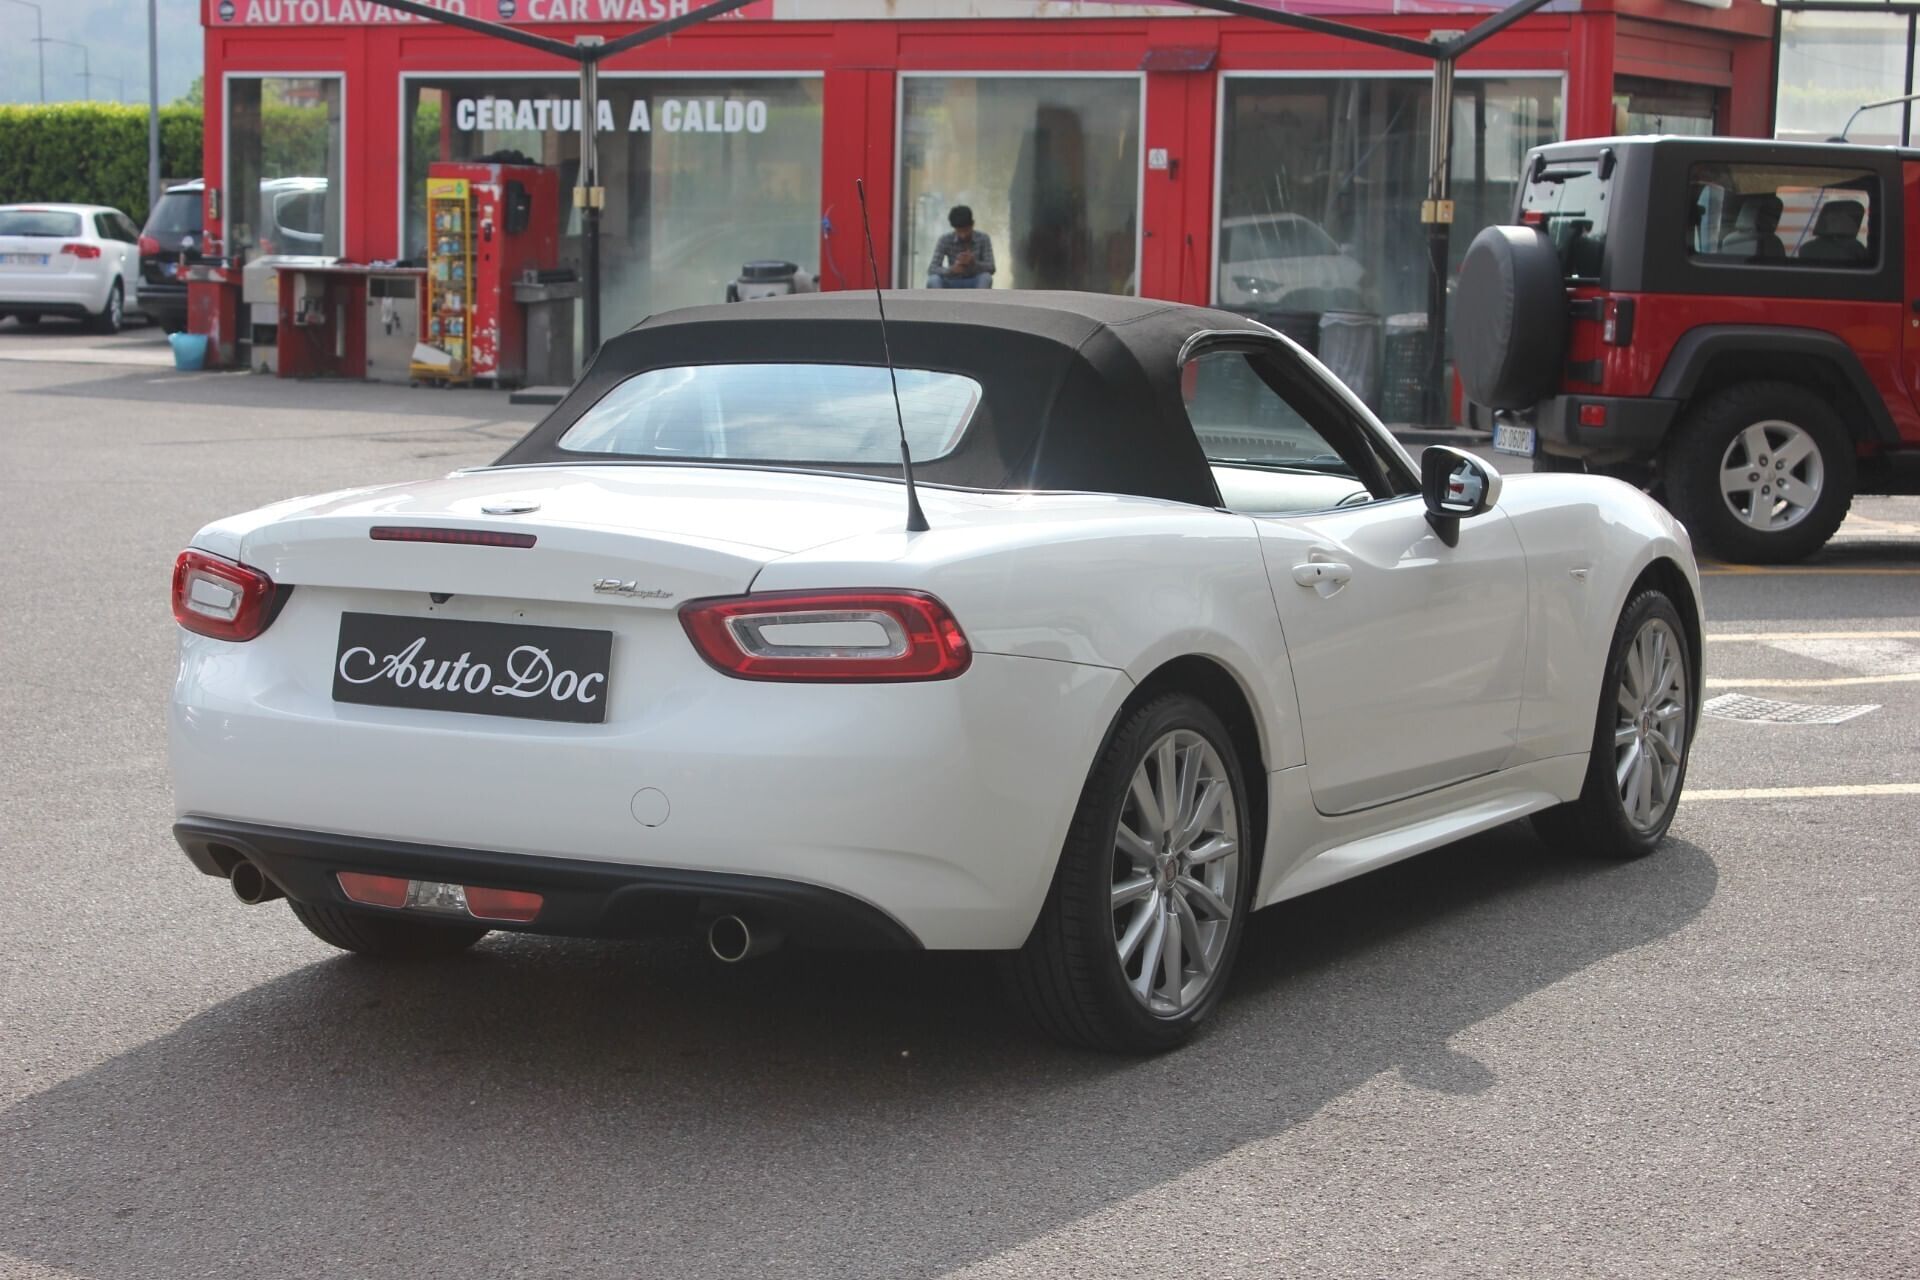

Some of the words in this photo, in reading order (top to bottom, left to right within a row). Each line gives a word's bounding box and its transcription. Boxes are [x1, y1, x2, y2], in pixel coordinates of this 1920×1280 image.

[528, 0, 589, 21] CAR
[598, 0, 689, 20] WASH
[628, 99, 650, 132] A
[661, 99, 767, 133] CALDO
[339, 636, 492, 694] Auto
[491, 645, 605, 703] Doc
